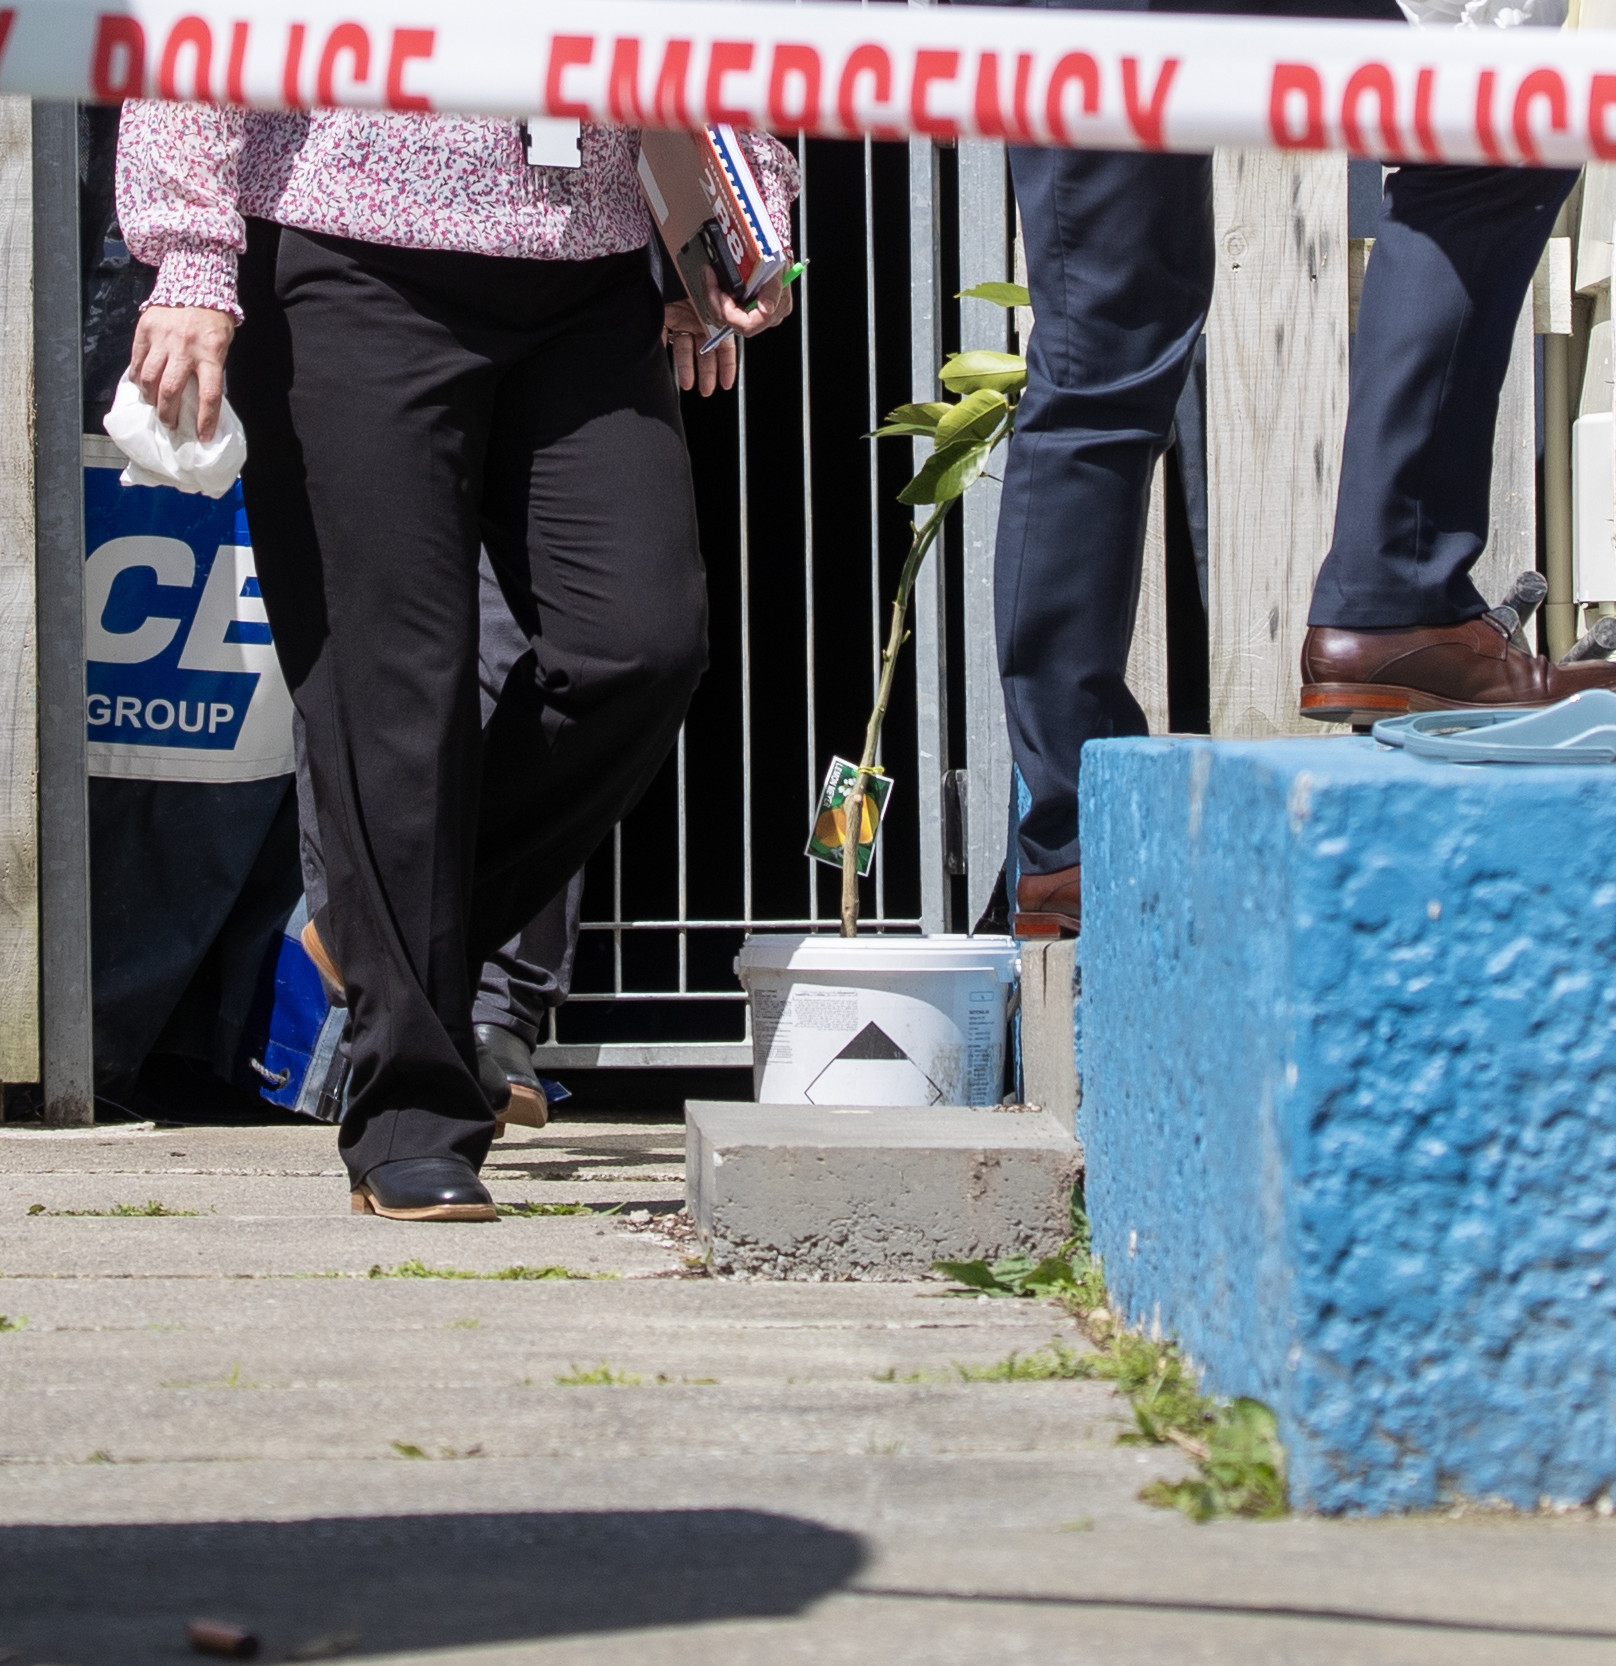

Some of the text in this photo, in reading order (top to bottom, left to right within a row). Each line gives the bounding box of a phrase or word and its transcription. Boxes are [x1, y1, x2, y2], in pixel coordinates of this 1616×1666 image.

[90, 14, 436, 112] POLICE
[543, 35, 1181, 151] EMERGENCY
[86, 694, 235, 734] GROUP
